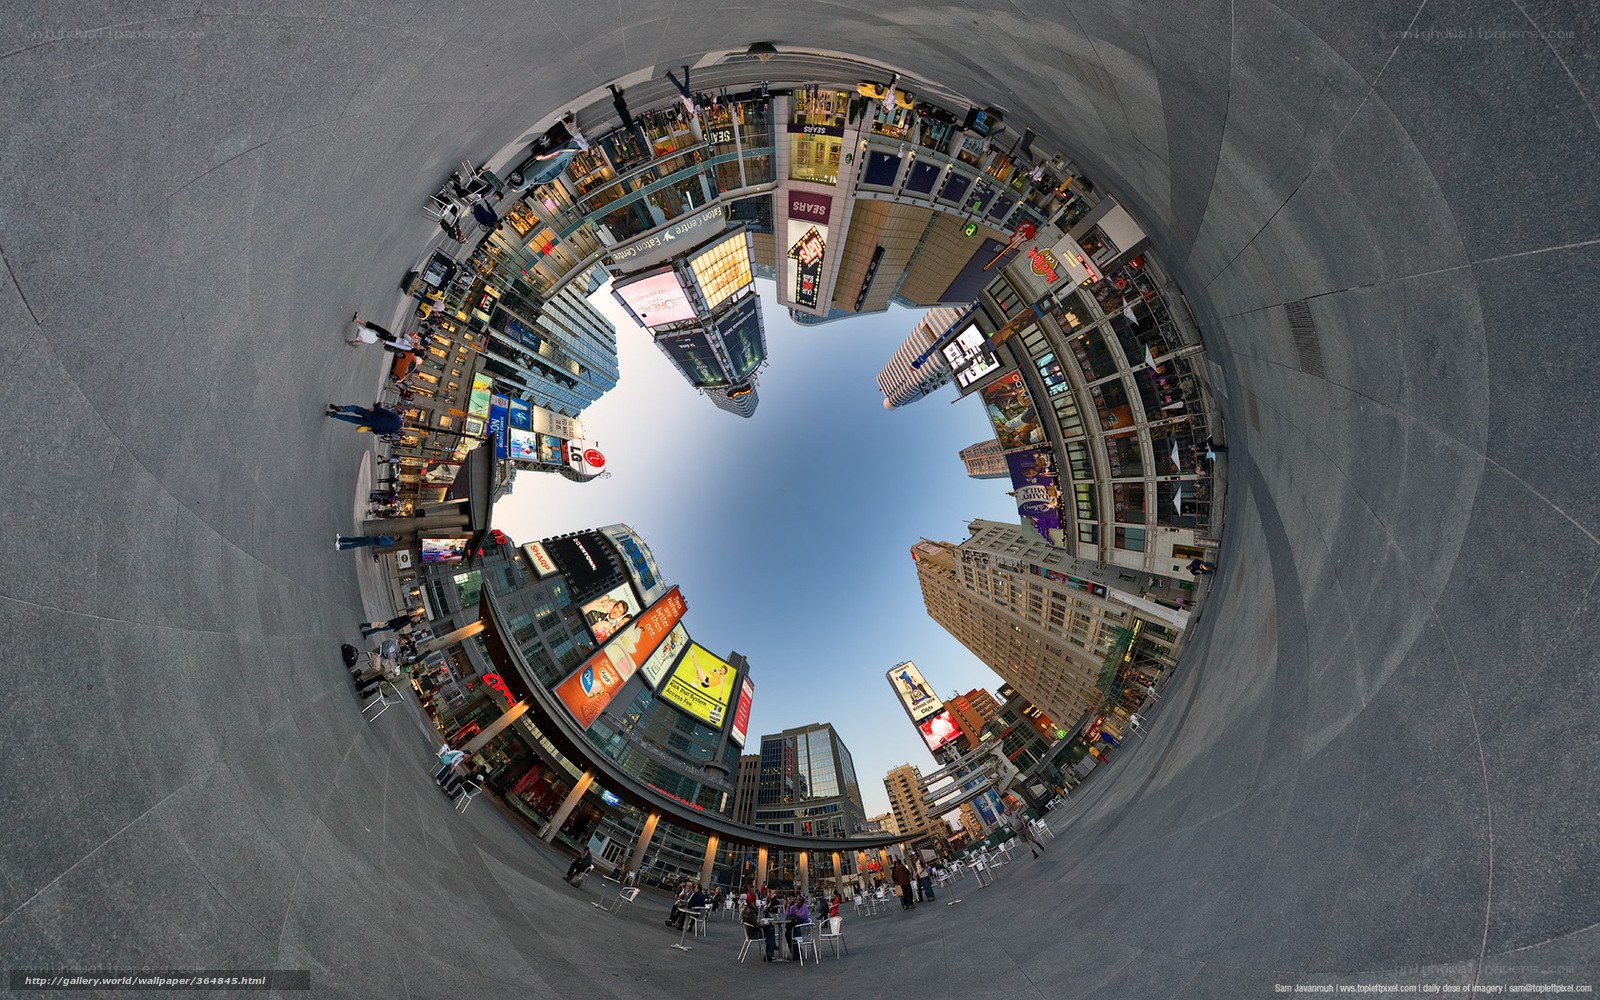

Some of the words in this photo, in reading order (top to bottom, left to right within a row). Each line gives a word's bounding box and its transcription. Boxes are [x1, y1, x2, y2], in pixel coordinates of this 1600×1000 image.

[703, 130, 731, 144] SEAS
[803, 124, 825, 134] SEARS
[702, 207, 721, 222] Eaton
[793, 202, 826, 215] SEARS
[675, 216, 702, 235] Centre
[613, 246, 636, 260] Centre
[636, 237, 661, 252] Eaton
[800, 238, 824, 264] days
[1026, 246, 1045, 268] Rock
[1039, 263, 1059, 284] Hard
[571, 445, 582, 462] LG
[531, 545, 550, 570] SHARP
[667, 597, 679, 617] halves
[674, 596, 682, 609] Two
[656, 607, 669, 628] better
[664, 607, 672, 618] are
[645, 623, 656, 639] one.
[650, 614, 663, 633] than
[483, 673, 518, 708] am
[666, 689, 683, 702] Access
[683, 697, 693, 708] Fee.
[670, 682, 680, 691] Kick
[680, 687, 689, 697] that
[689, 694, 707, 707] System
